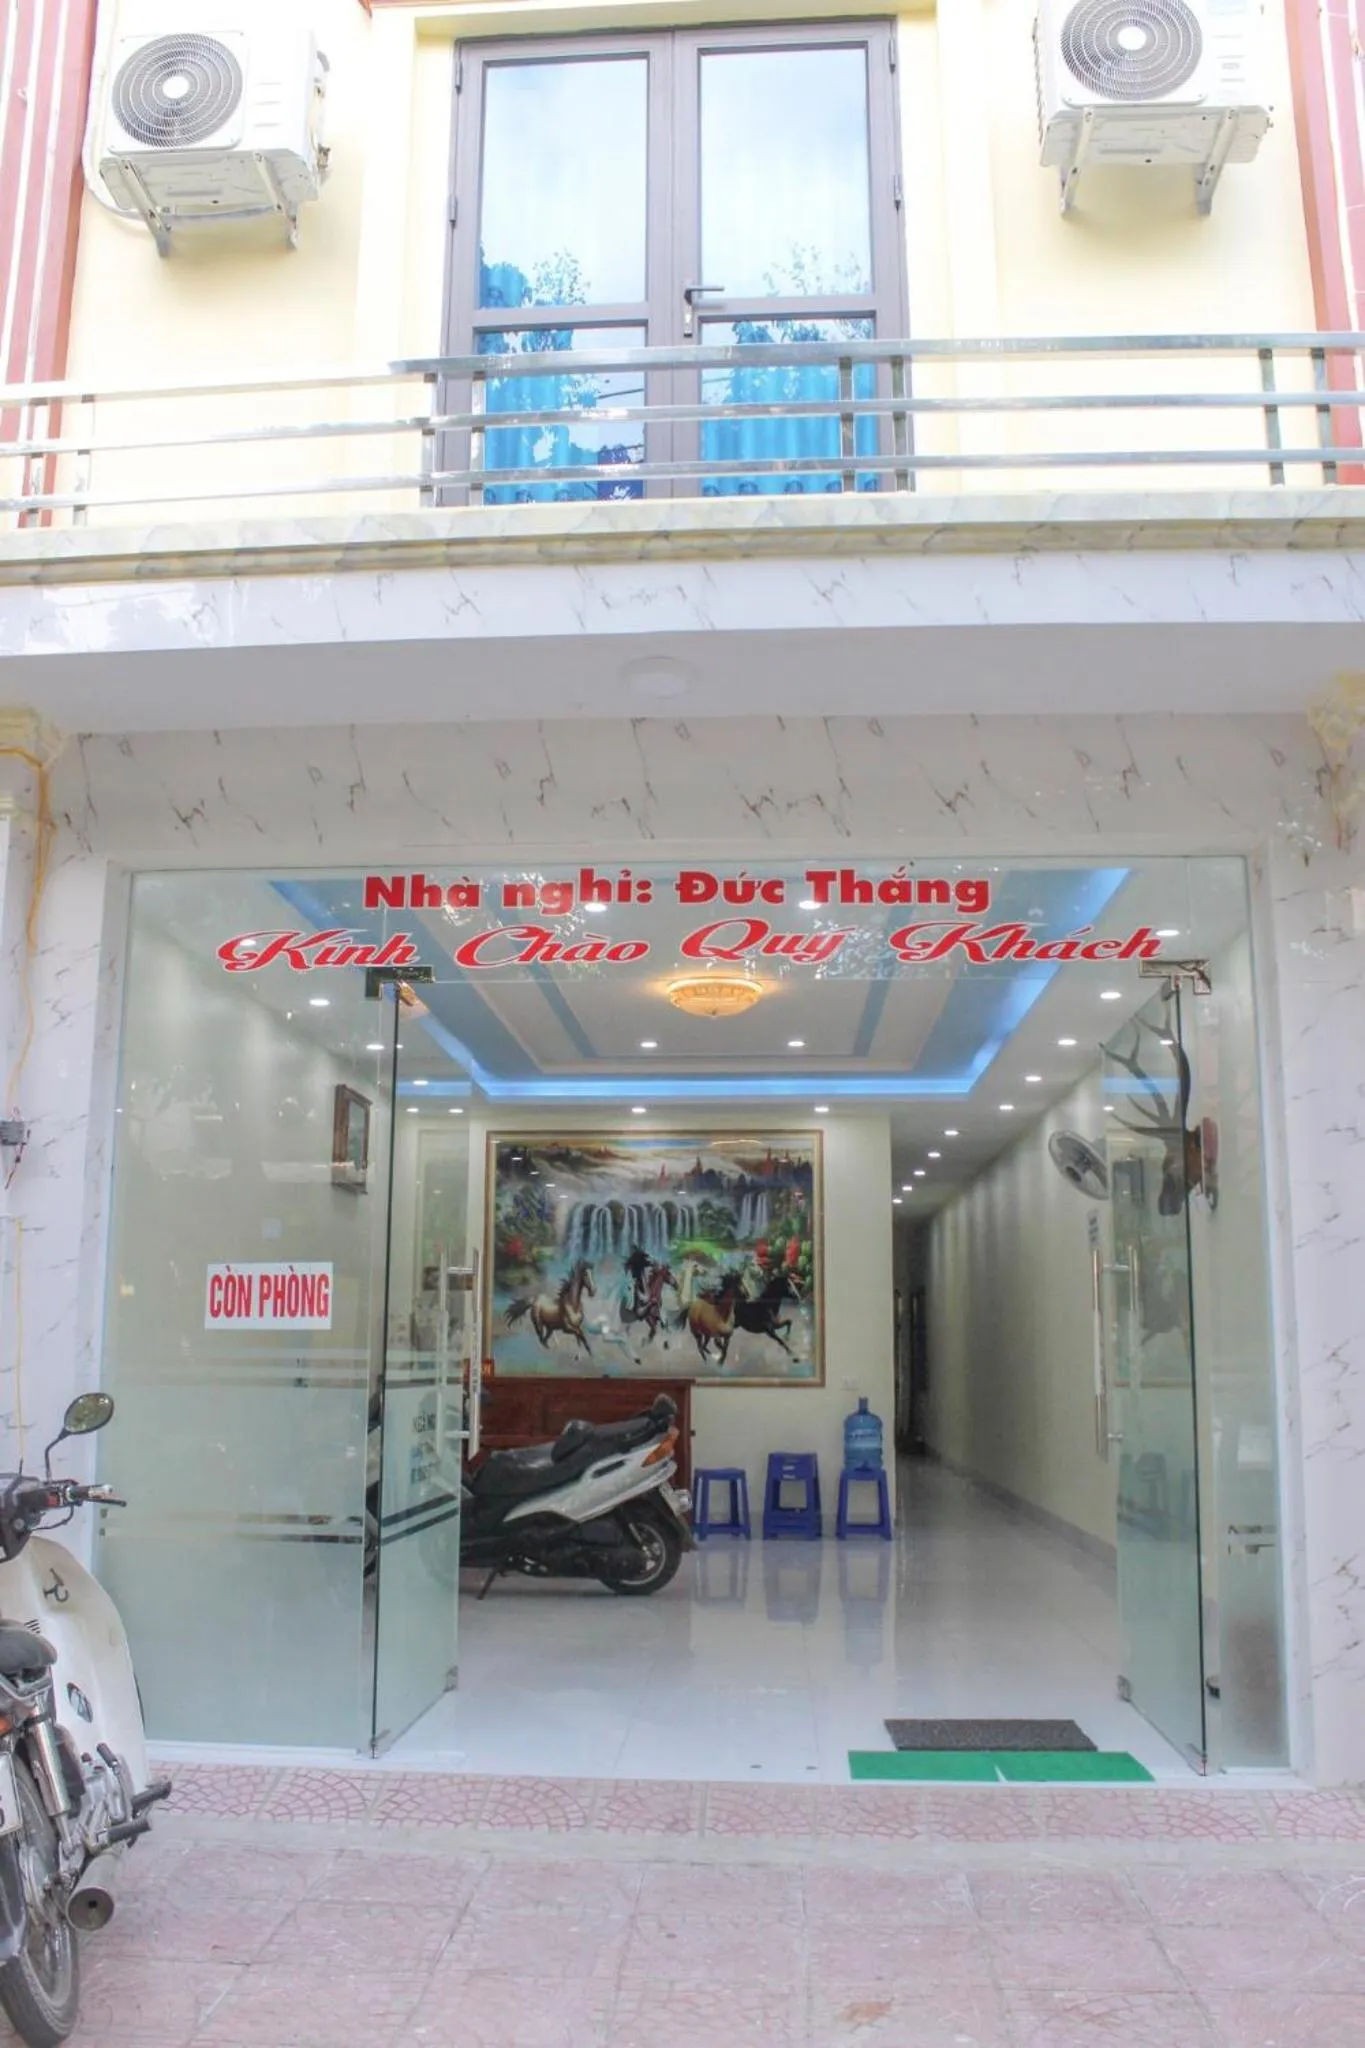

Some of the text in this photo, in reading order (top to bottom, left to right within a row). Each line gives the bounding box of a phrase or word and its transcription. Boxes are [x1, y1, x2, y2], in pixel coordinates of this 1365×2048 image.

[363, 866, 991, 916] Nhà nghỉ: Đức Thắng
[216, 916, 1163, 973] Kính Chào Quý Khách
[208, 1264, 330, 1318] CÒN PHÒNG
